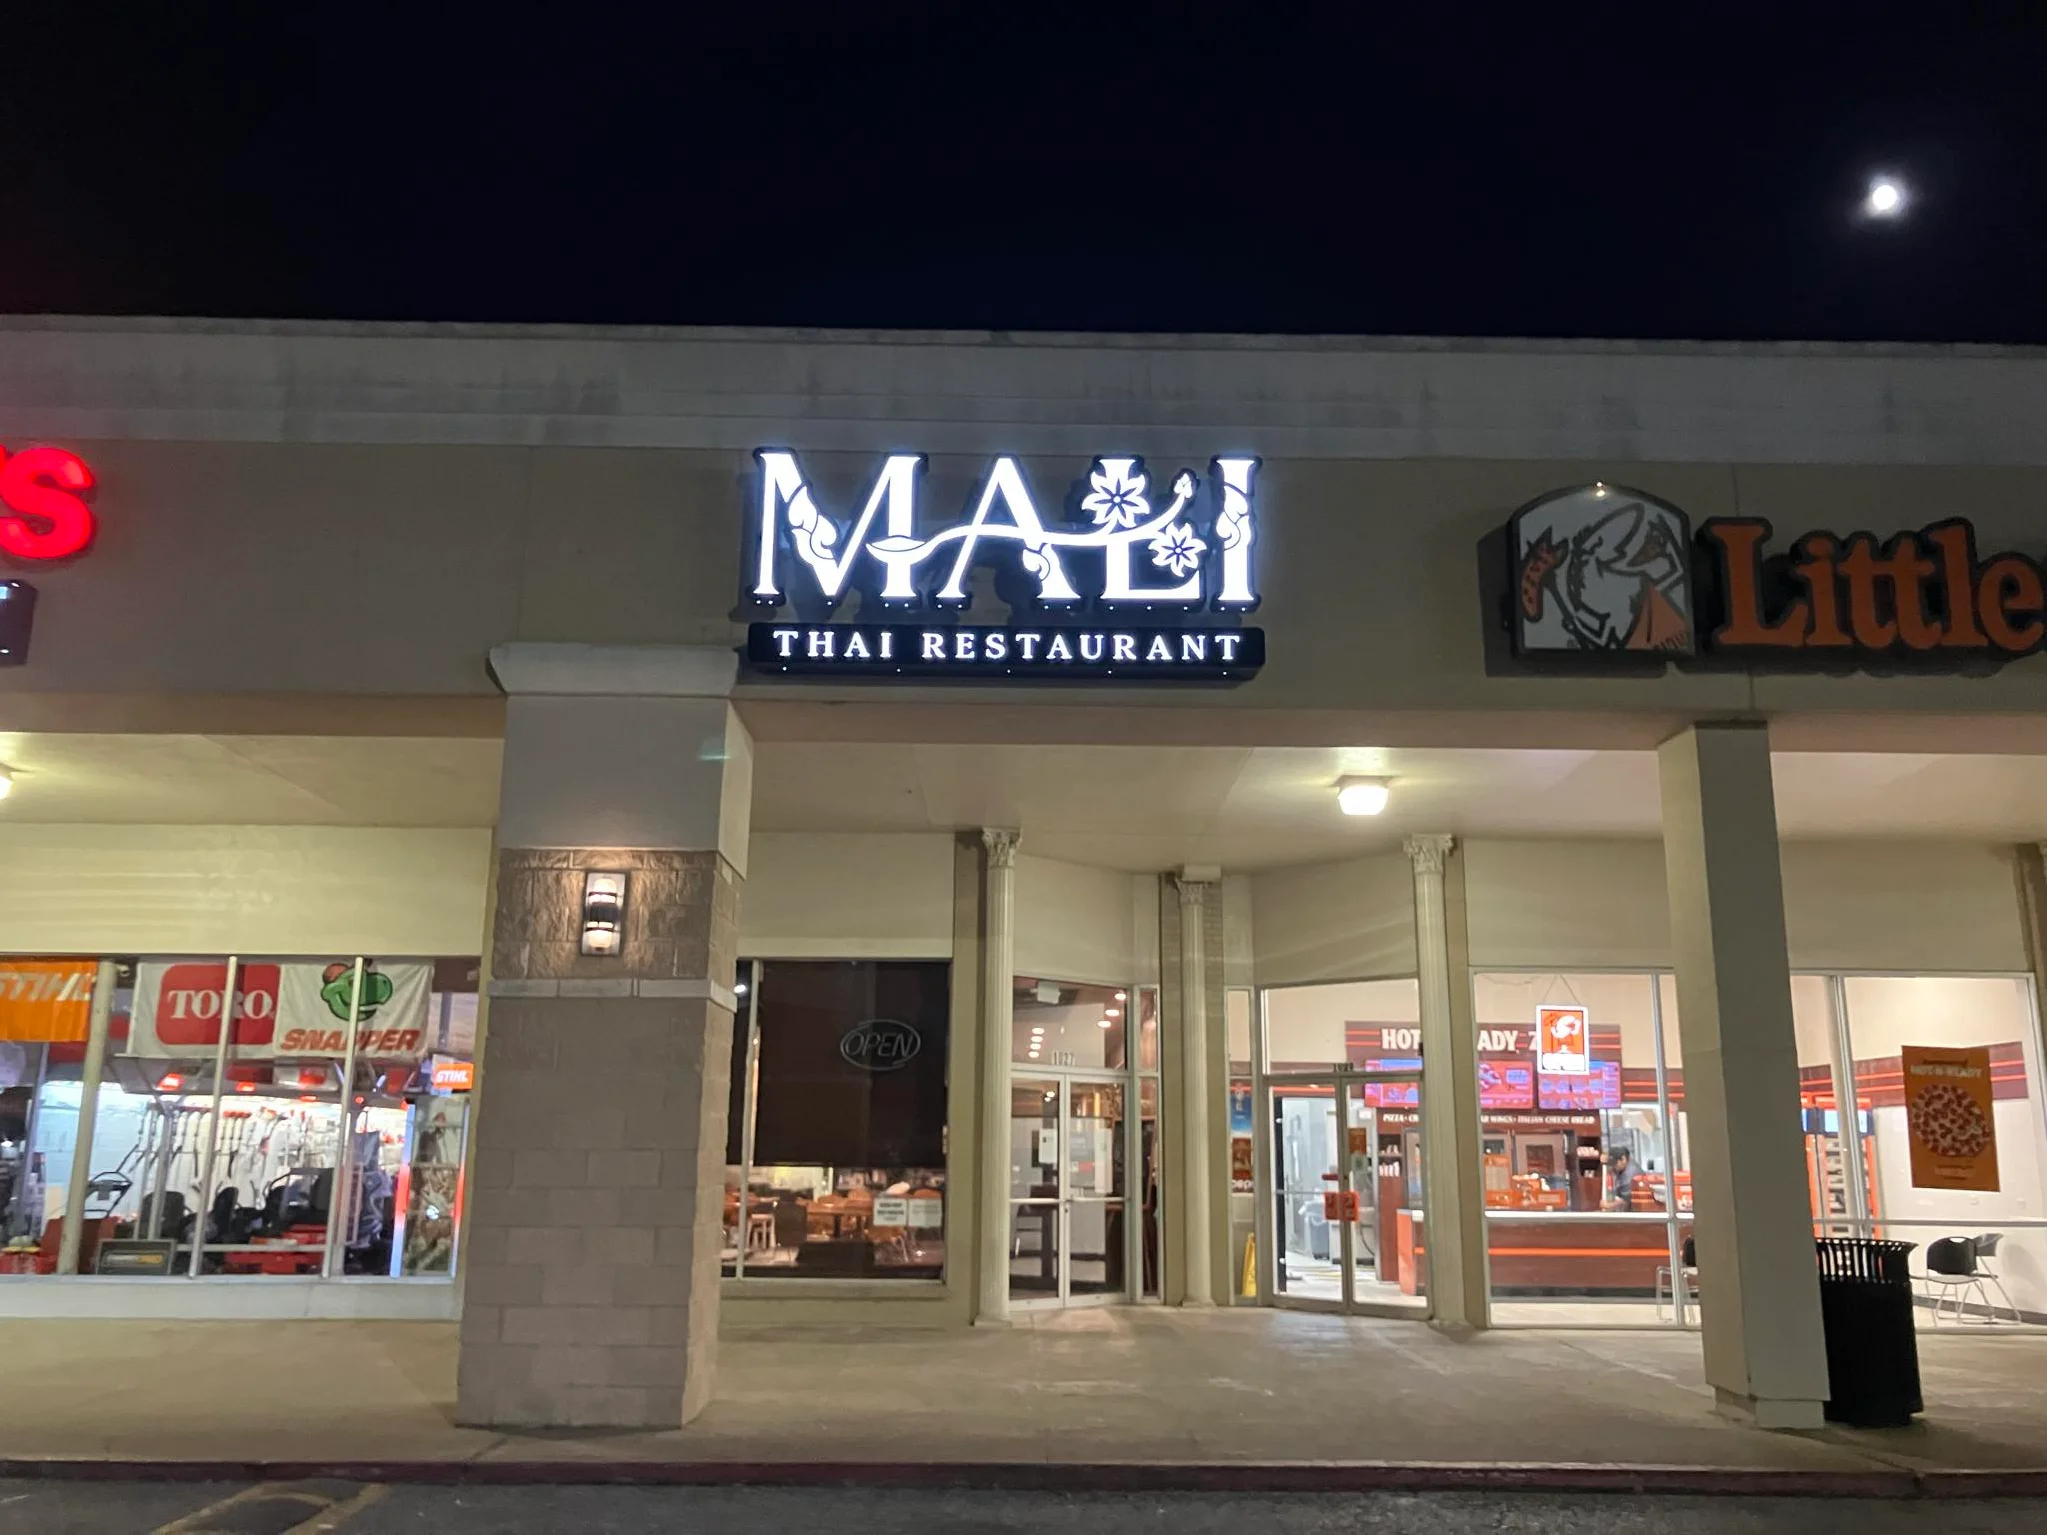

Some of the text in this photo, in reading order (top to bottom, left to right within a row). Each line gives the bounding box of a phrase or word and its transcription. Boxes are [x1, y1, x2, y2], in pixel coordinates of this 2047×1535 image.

[754, 453, 1257, 600] MALI
[1710, 523, 2046, 650] Little
[773, 630, 1242, 661] THAI RESTAURANT
[845, 1031, 914, 1057] OPEN
[1477, 1029, 1518, 1052] ADY
[436, 1069, 469, 1083] STIHL
